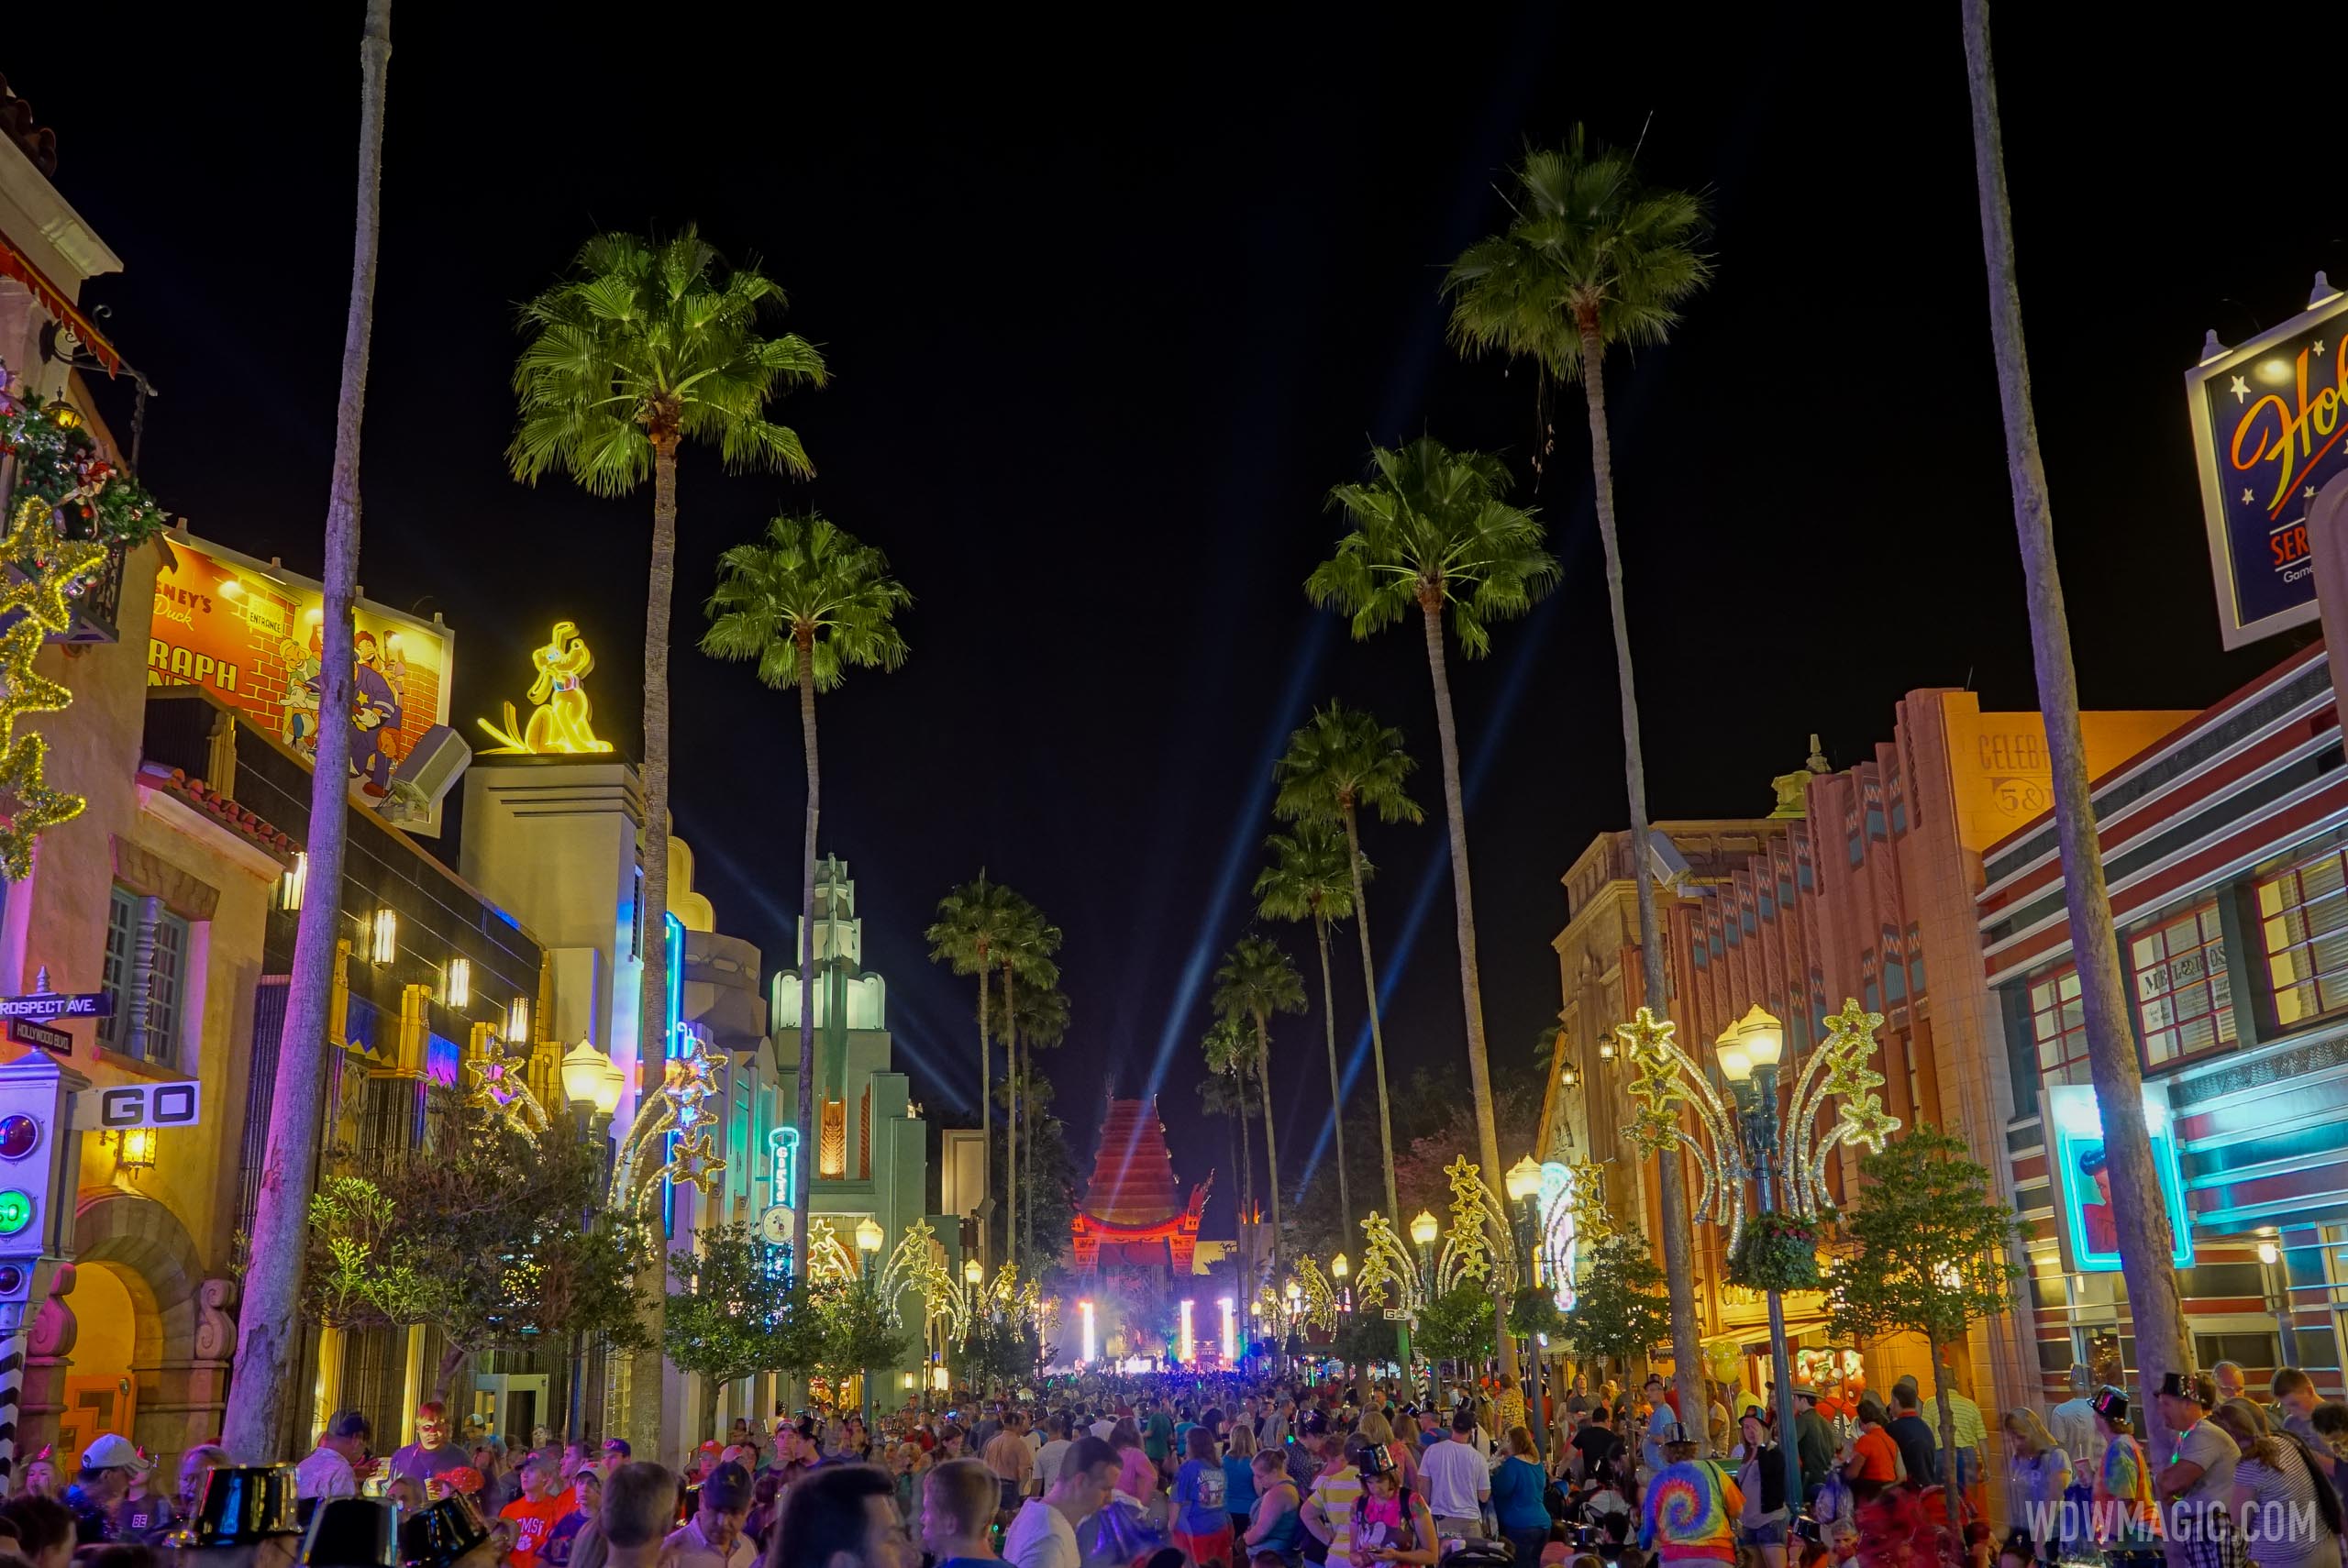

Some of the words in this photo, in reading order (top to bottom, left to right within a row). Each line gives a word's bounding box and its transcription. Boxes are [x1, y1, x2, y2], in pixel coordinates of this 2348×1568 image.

[2270, 525, 2310, 566] SER
[154, 593, 194, 631] Duck
[249, 612, 282, 634] ENTRANCE
[148, 638, 238, 691] RAPH
[66, 999, 96, 1012] AVE.
[17, 1022, 53, 1045] HOLLYWOOD
[102, 1085, 194, 1127] GO
[775, 1146, 789, 1202] GIFTS
